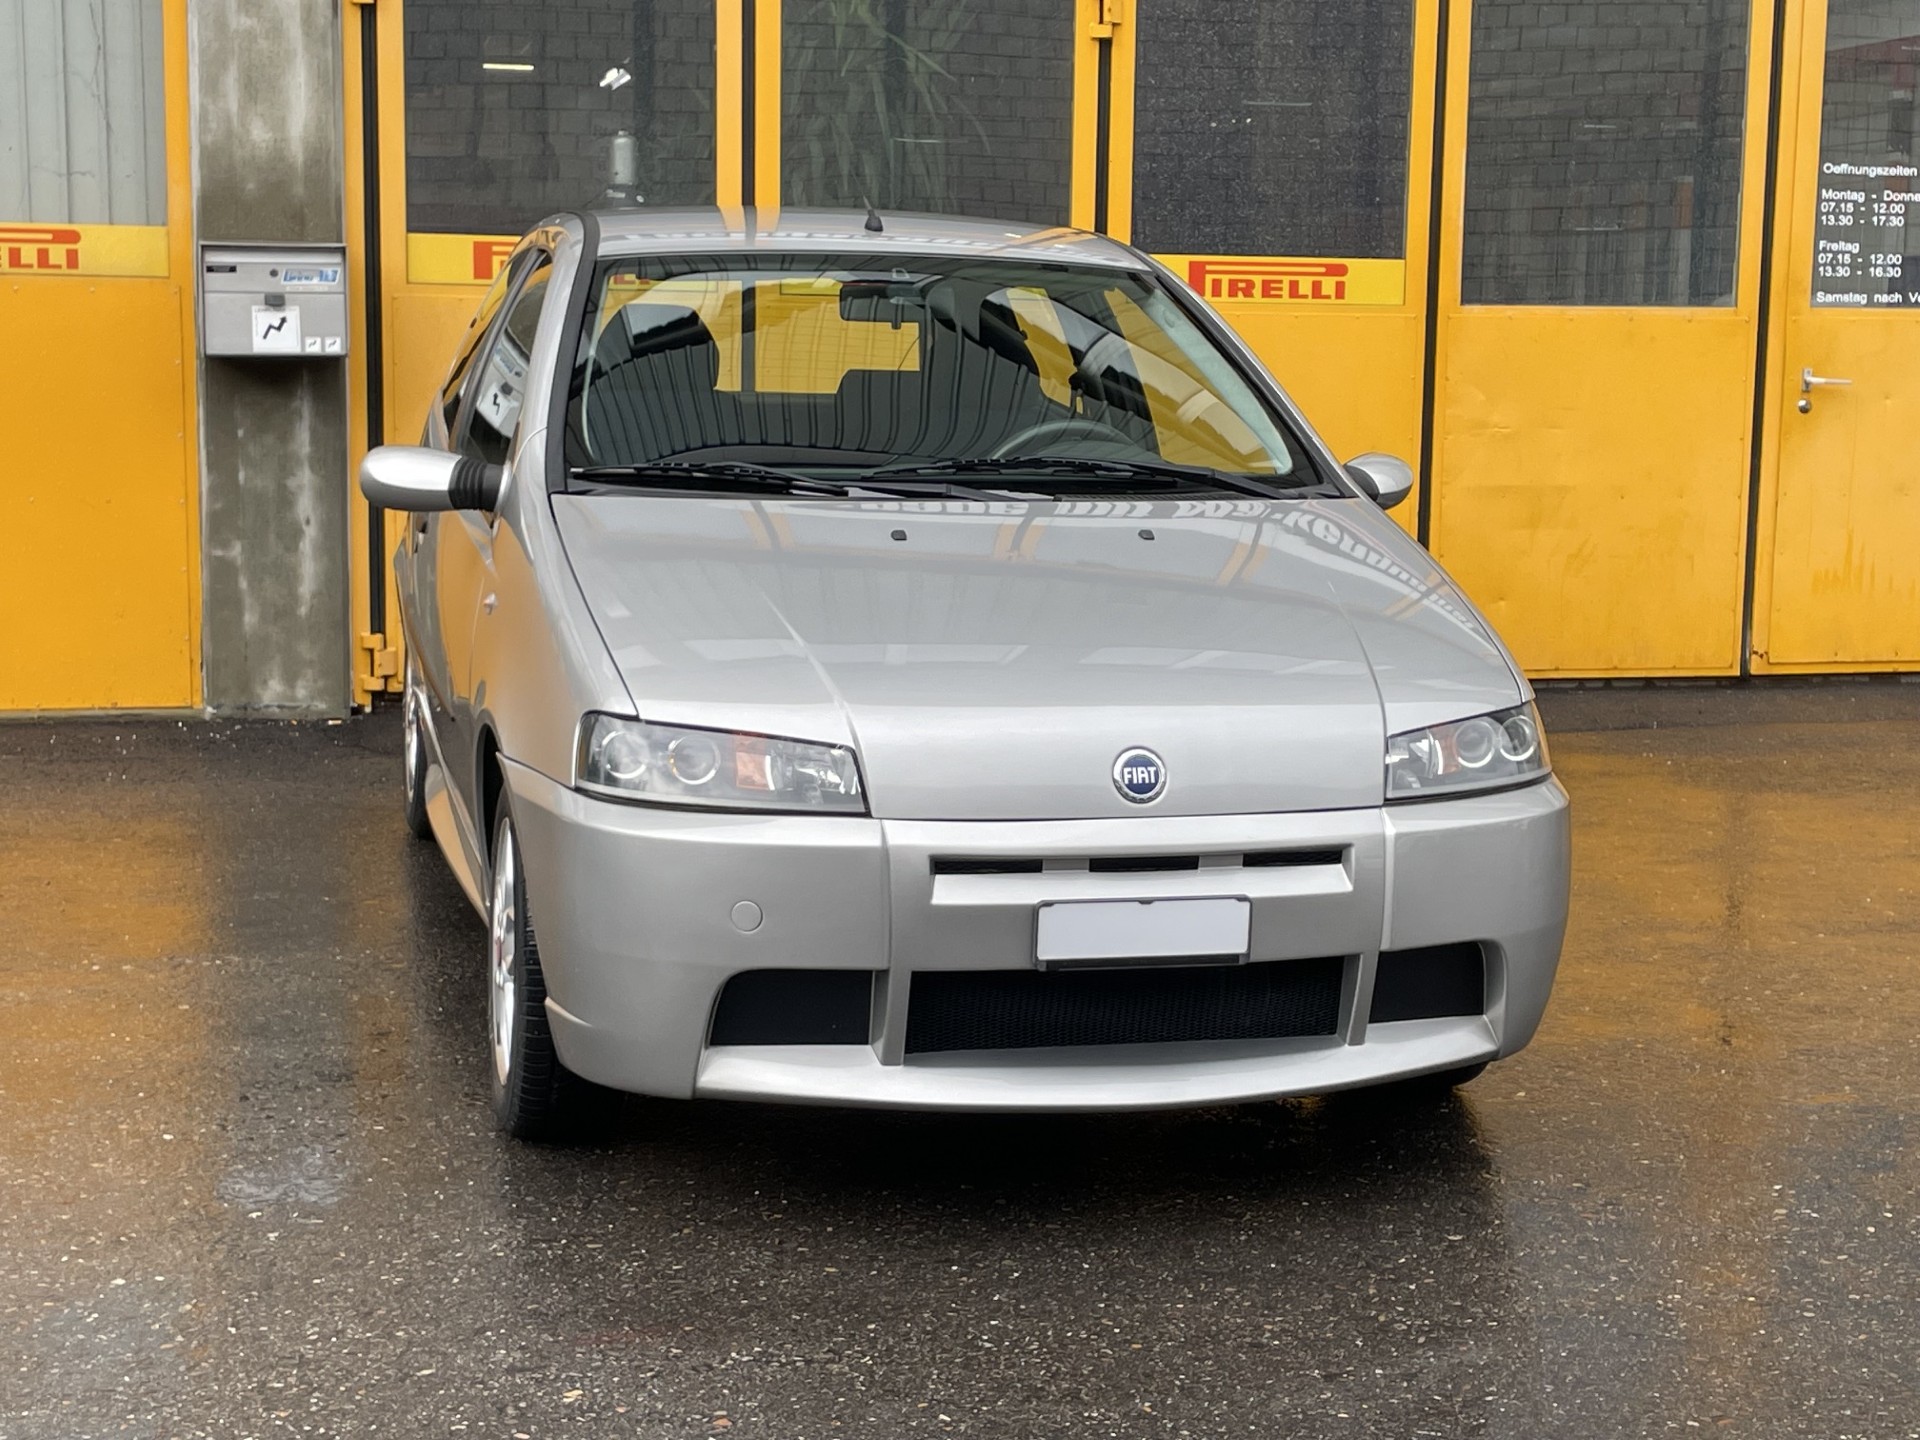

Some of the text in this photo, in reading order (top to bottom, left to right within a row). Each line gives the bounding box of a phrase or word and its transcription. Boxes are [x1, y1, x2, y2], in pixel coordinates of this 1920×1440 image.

[1823, 162, 1918, 178] Oeffnungszeiten
[1821, 188, 1866, 203] Montag
[1821, 202, 1854, 213] 07.15
[1872, 203, 1905, 214] 12.00
[1821, 214, 1854, 226] 13.30
[1872, 215, 1905, 227] 17.30
[1819, 240, 1860, 254] Freitag
[1818, 253, 1851, 264] 07.15
[1869, 253, 1903, 265] 12.00
[1818, 266, 1851, 277] 13.30
[1868, 266, 1902, 278] 16.30
[1188, 261, 1349, 300] PIRELLI
[1816, 291, 1868, 305] Samstag
[1873, 291, 1903, 303] nach
[1123, 766, 1157, 785] FIAT
